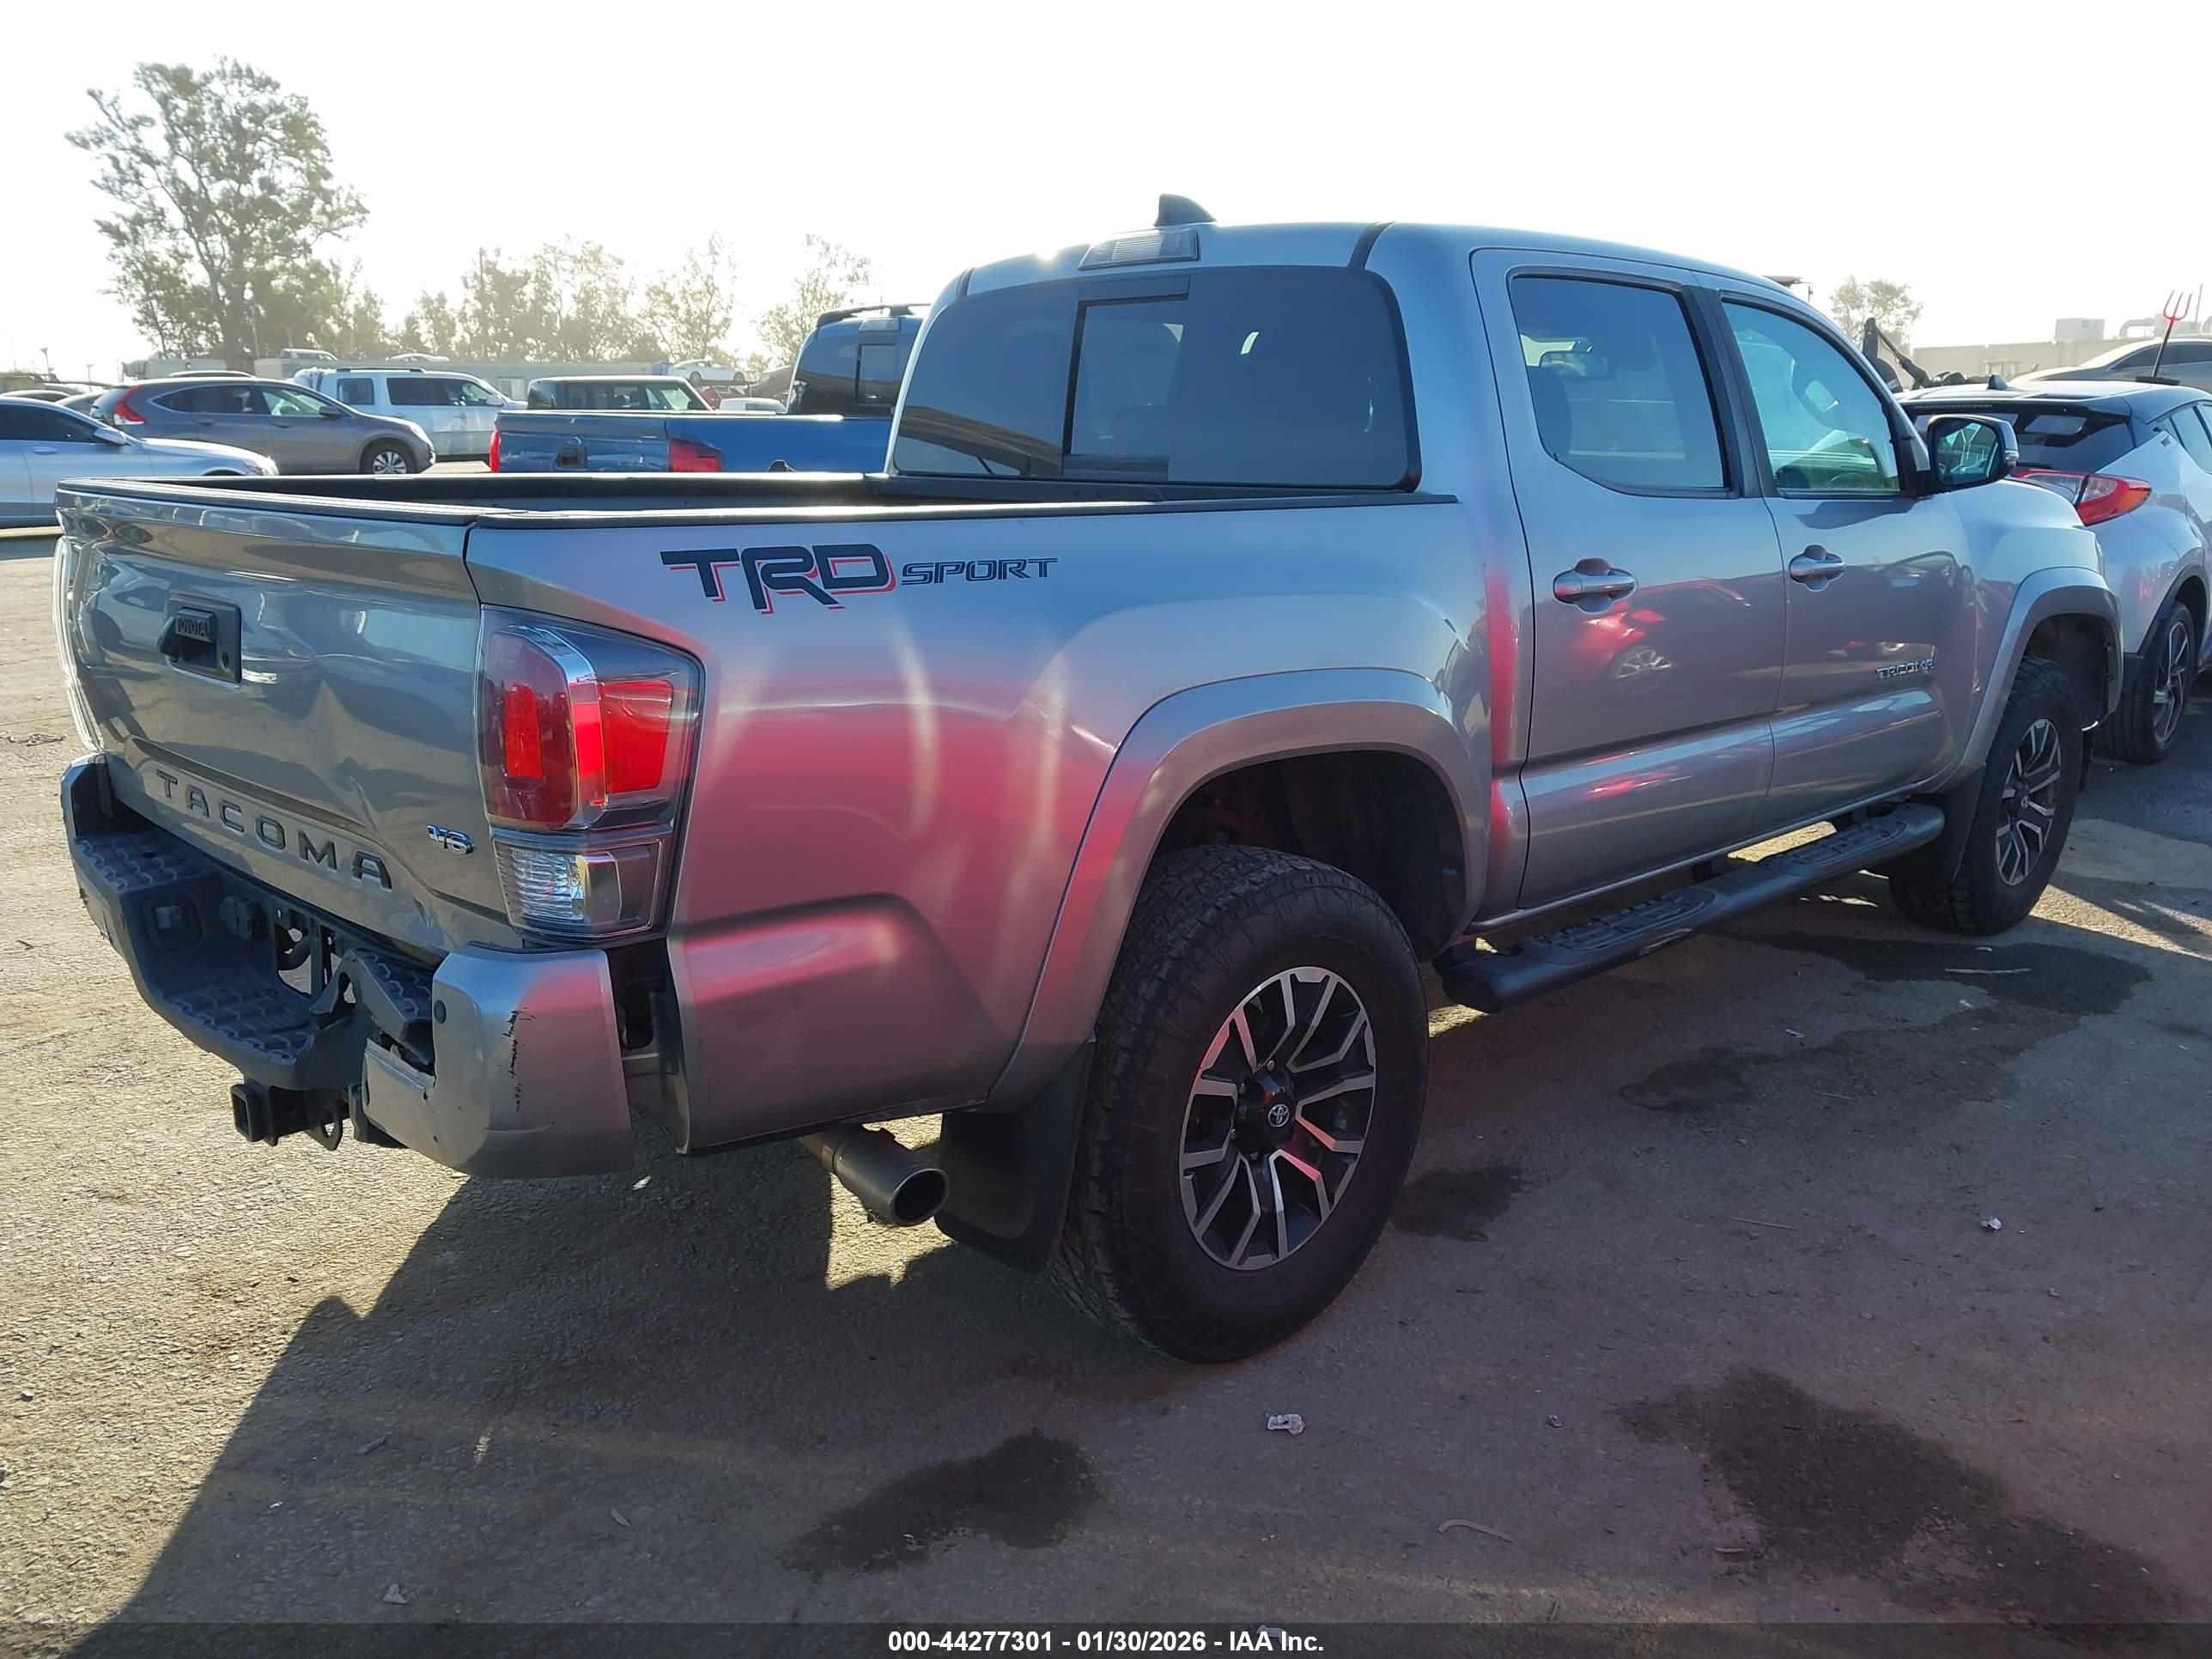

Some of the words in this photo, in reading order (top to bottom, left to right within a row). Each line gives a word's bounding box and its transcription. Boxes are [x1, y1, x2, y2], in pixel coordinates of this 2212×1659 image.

[660, 544, 896, 615] TRD
[901, 557, 1058, 586] SPORT
[177, 616, 209, 638] TOYOTA
[1875, 659, 1936, 680] TACOMA
[155, 771, 393, 890] TACOMA
[426, 823, 474, 855] V6
